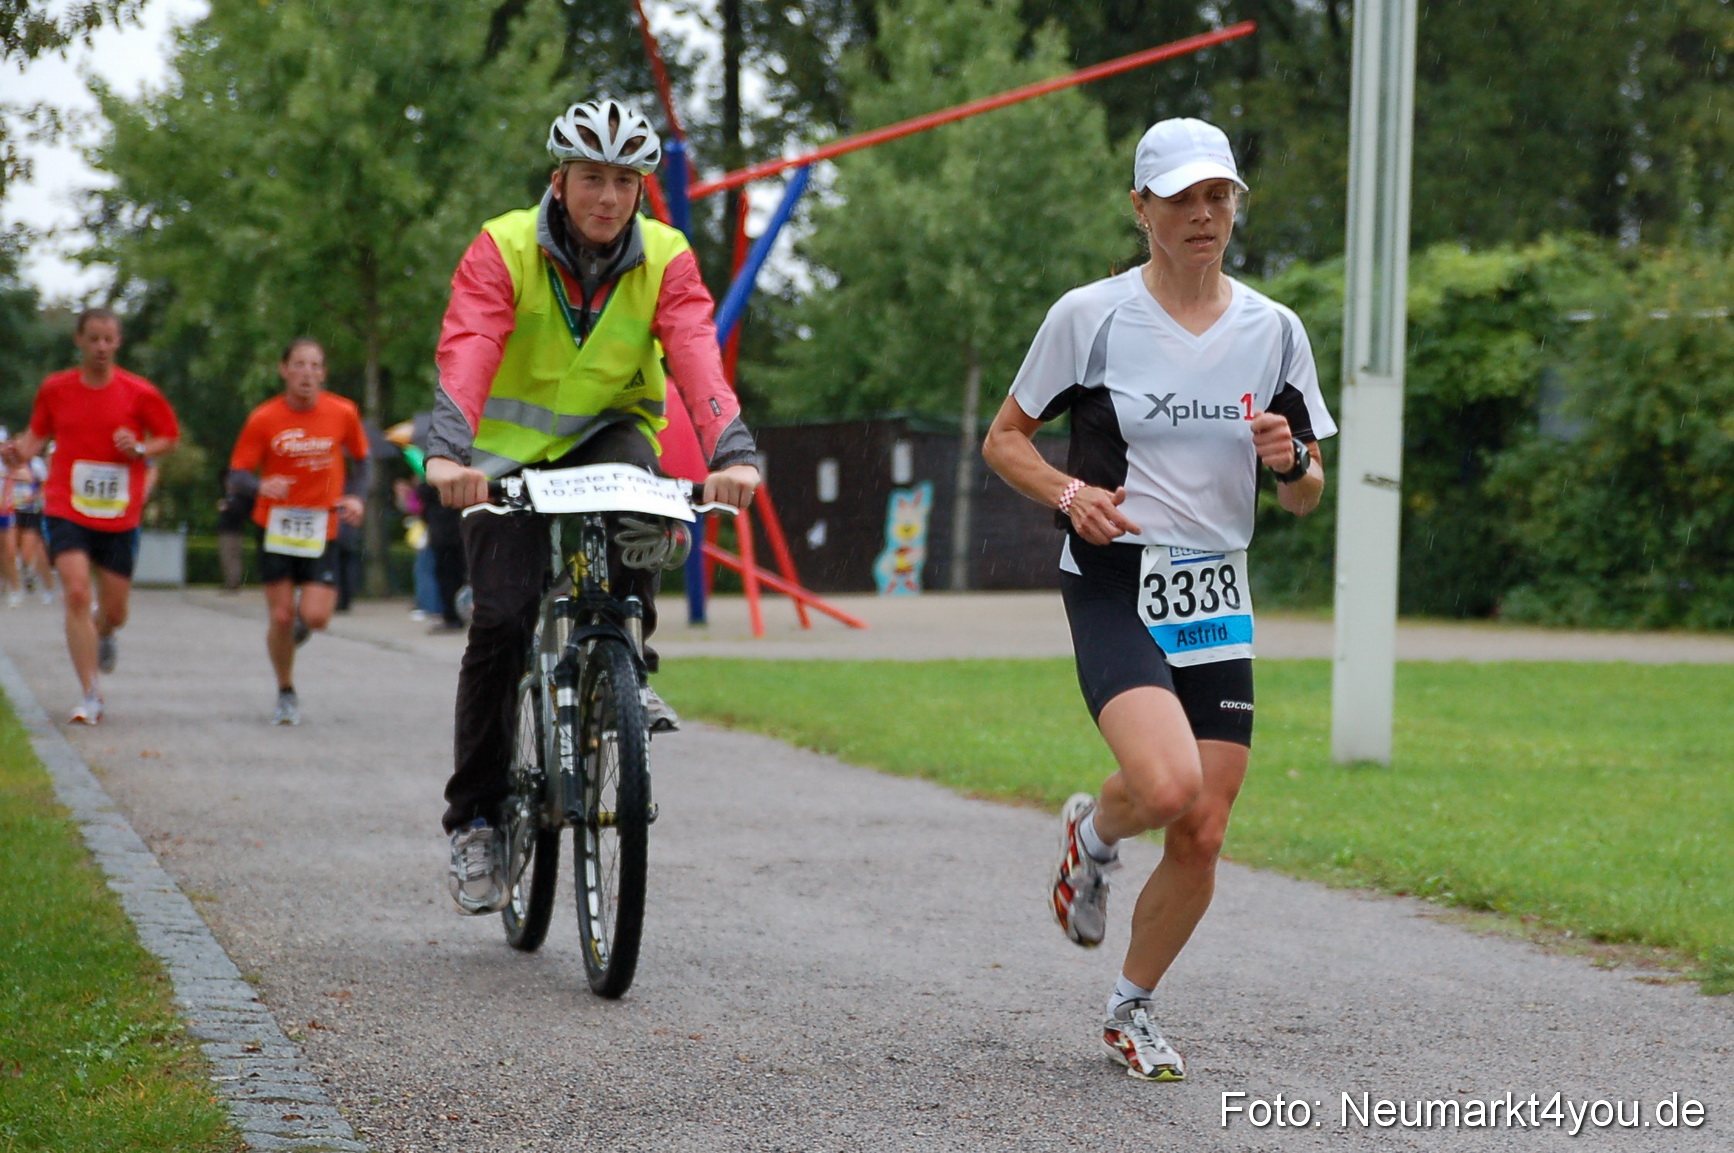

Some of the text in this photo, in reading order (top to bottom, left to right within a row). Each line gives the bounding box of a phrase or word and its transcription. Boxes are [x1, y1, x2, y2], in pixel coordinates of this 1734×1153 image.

[550, 473, 660, 487] Erste Frau
[593, 485, 624, 493] km
[1143, 564, 1241, 621] 3338
[1176, 623, 1228, 647] Astrid
